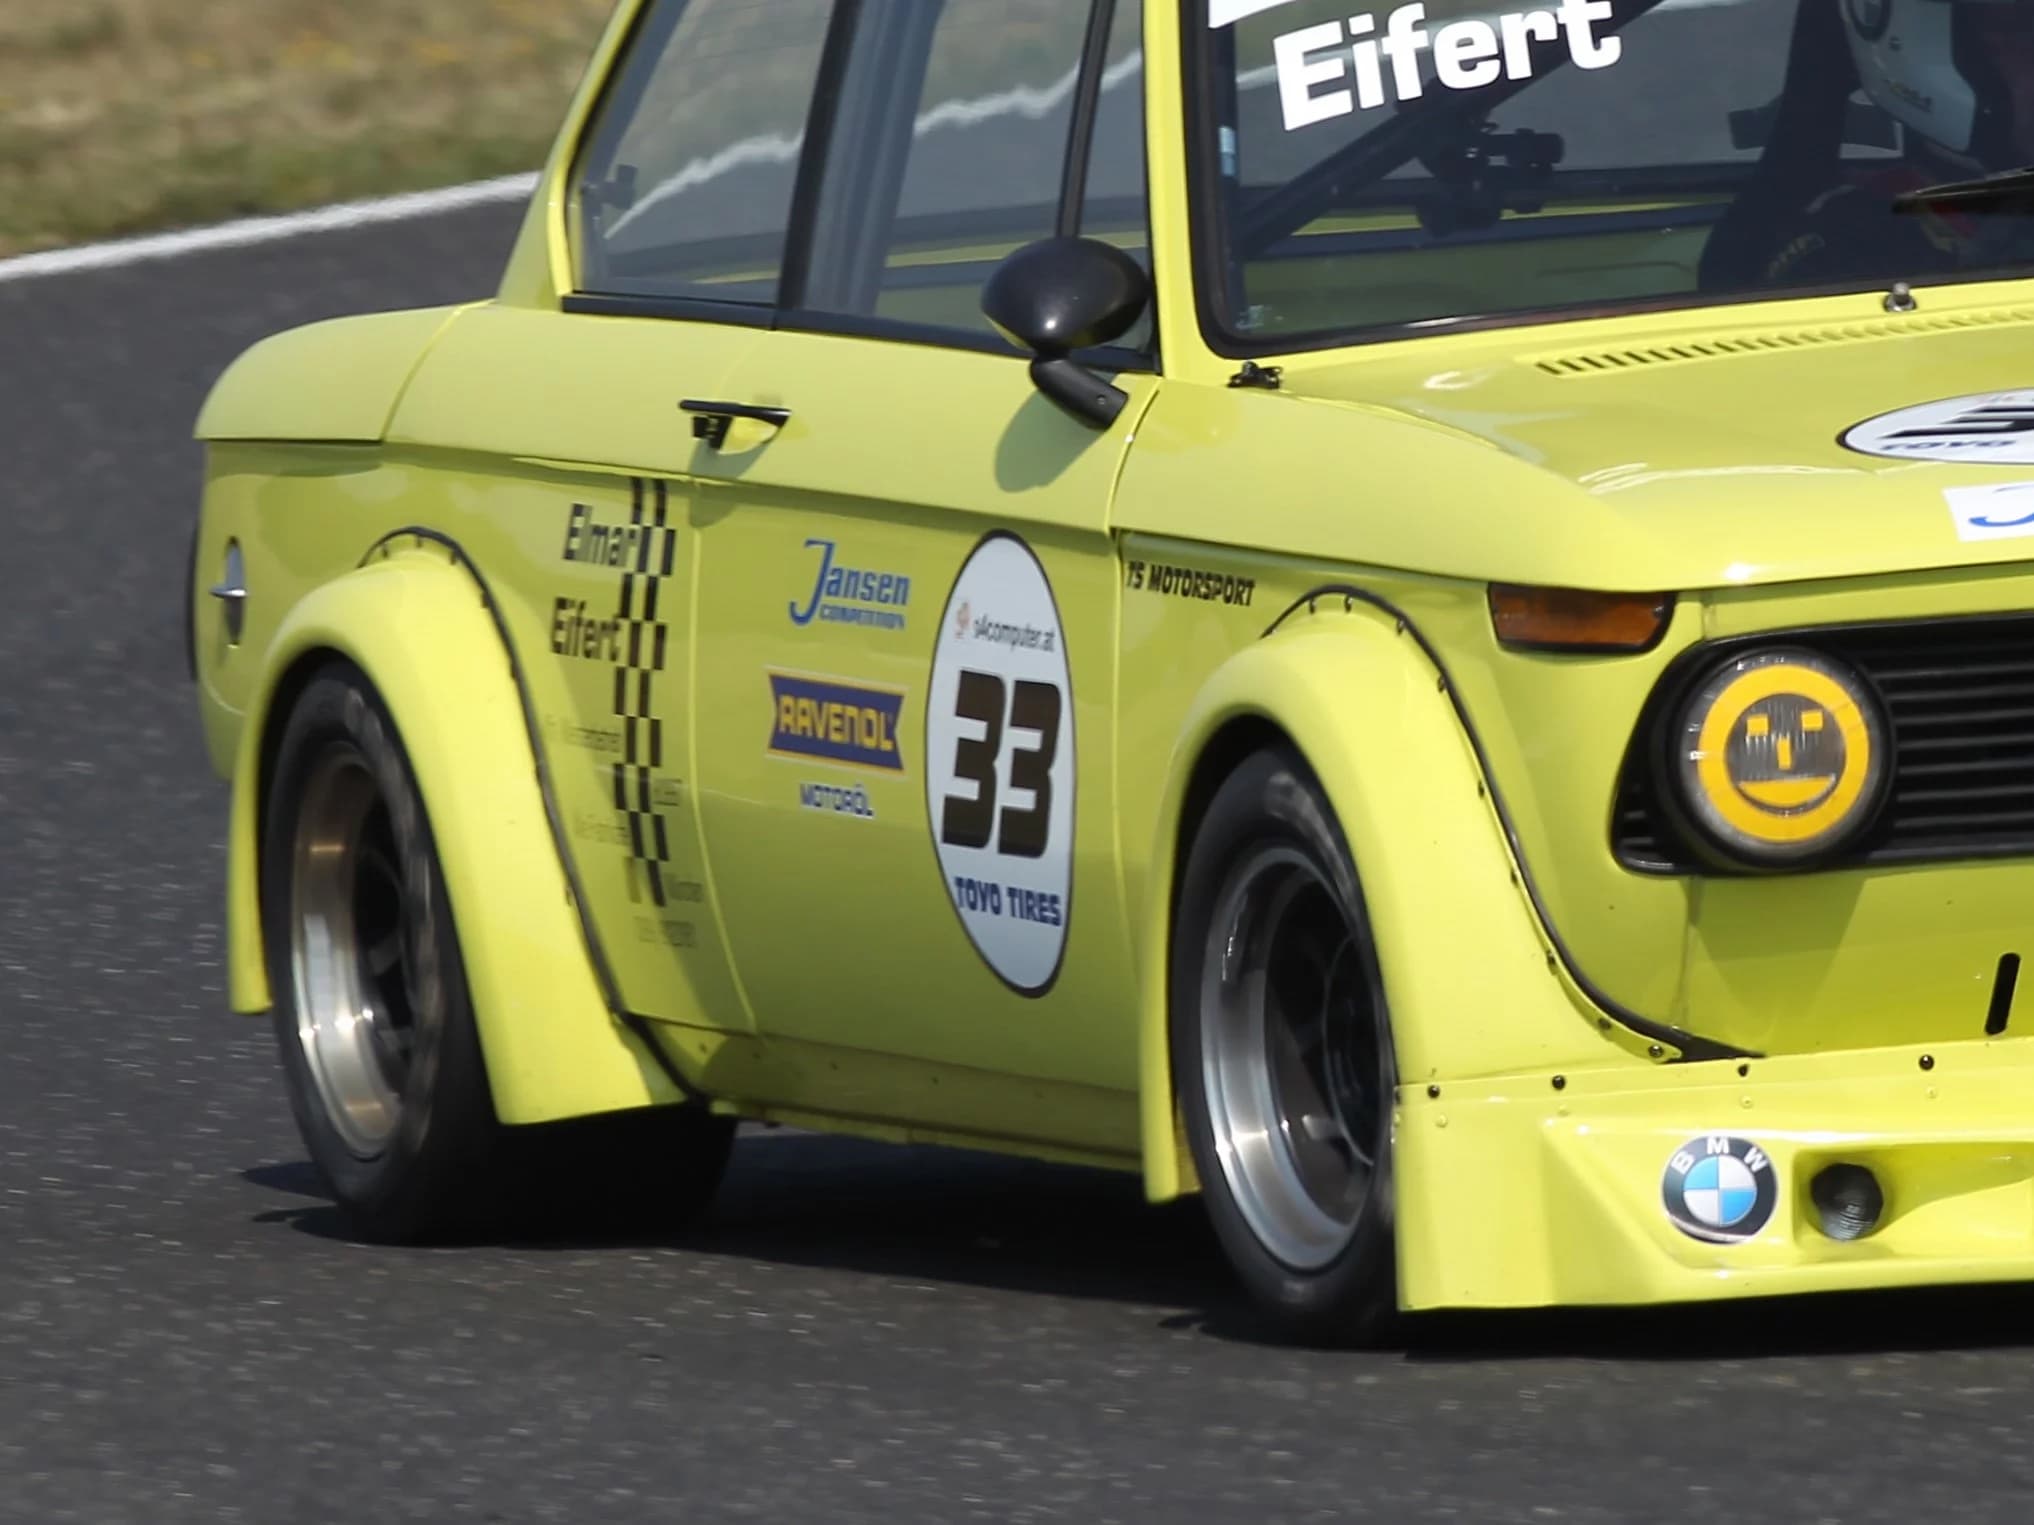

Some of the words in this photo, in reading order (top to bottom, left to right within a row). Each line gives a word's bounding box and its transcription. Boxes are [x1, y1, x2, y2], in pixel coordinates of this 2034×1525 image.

[1273, 0, 1621, 131] Eifert
[563, 502, 640, 567] Elmar
[789, 538, 910, 627] Jansen
[1148, 564, 1256, 607] MOTORSPORT
[551, 597, 622, 662] Eifert
[778, 693, 894, 752] RAVENOL
[941, 669, 1061, 859] 33
[954, 876, 1002, 915] TOYO
[1006, 886, 1062, 927] TIRES
